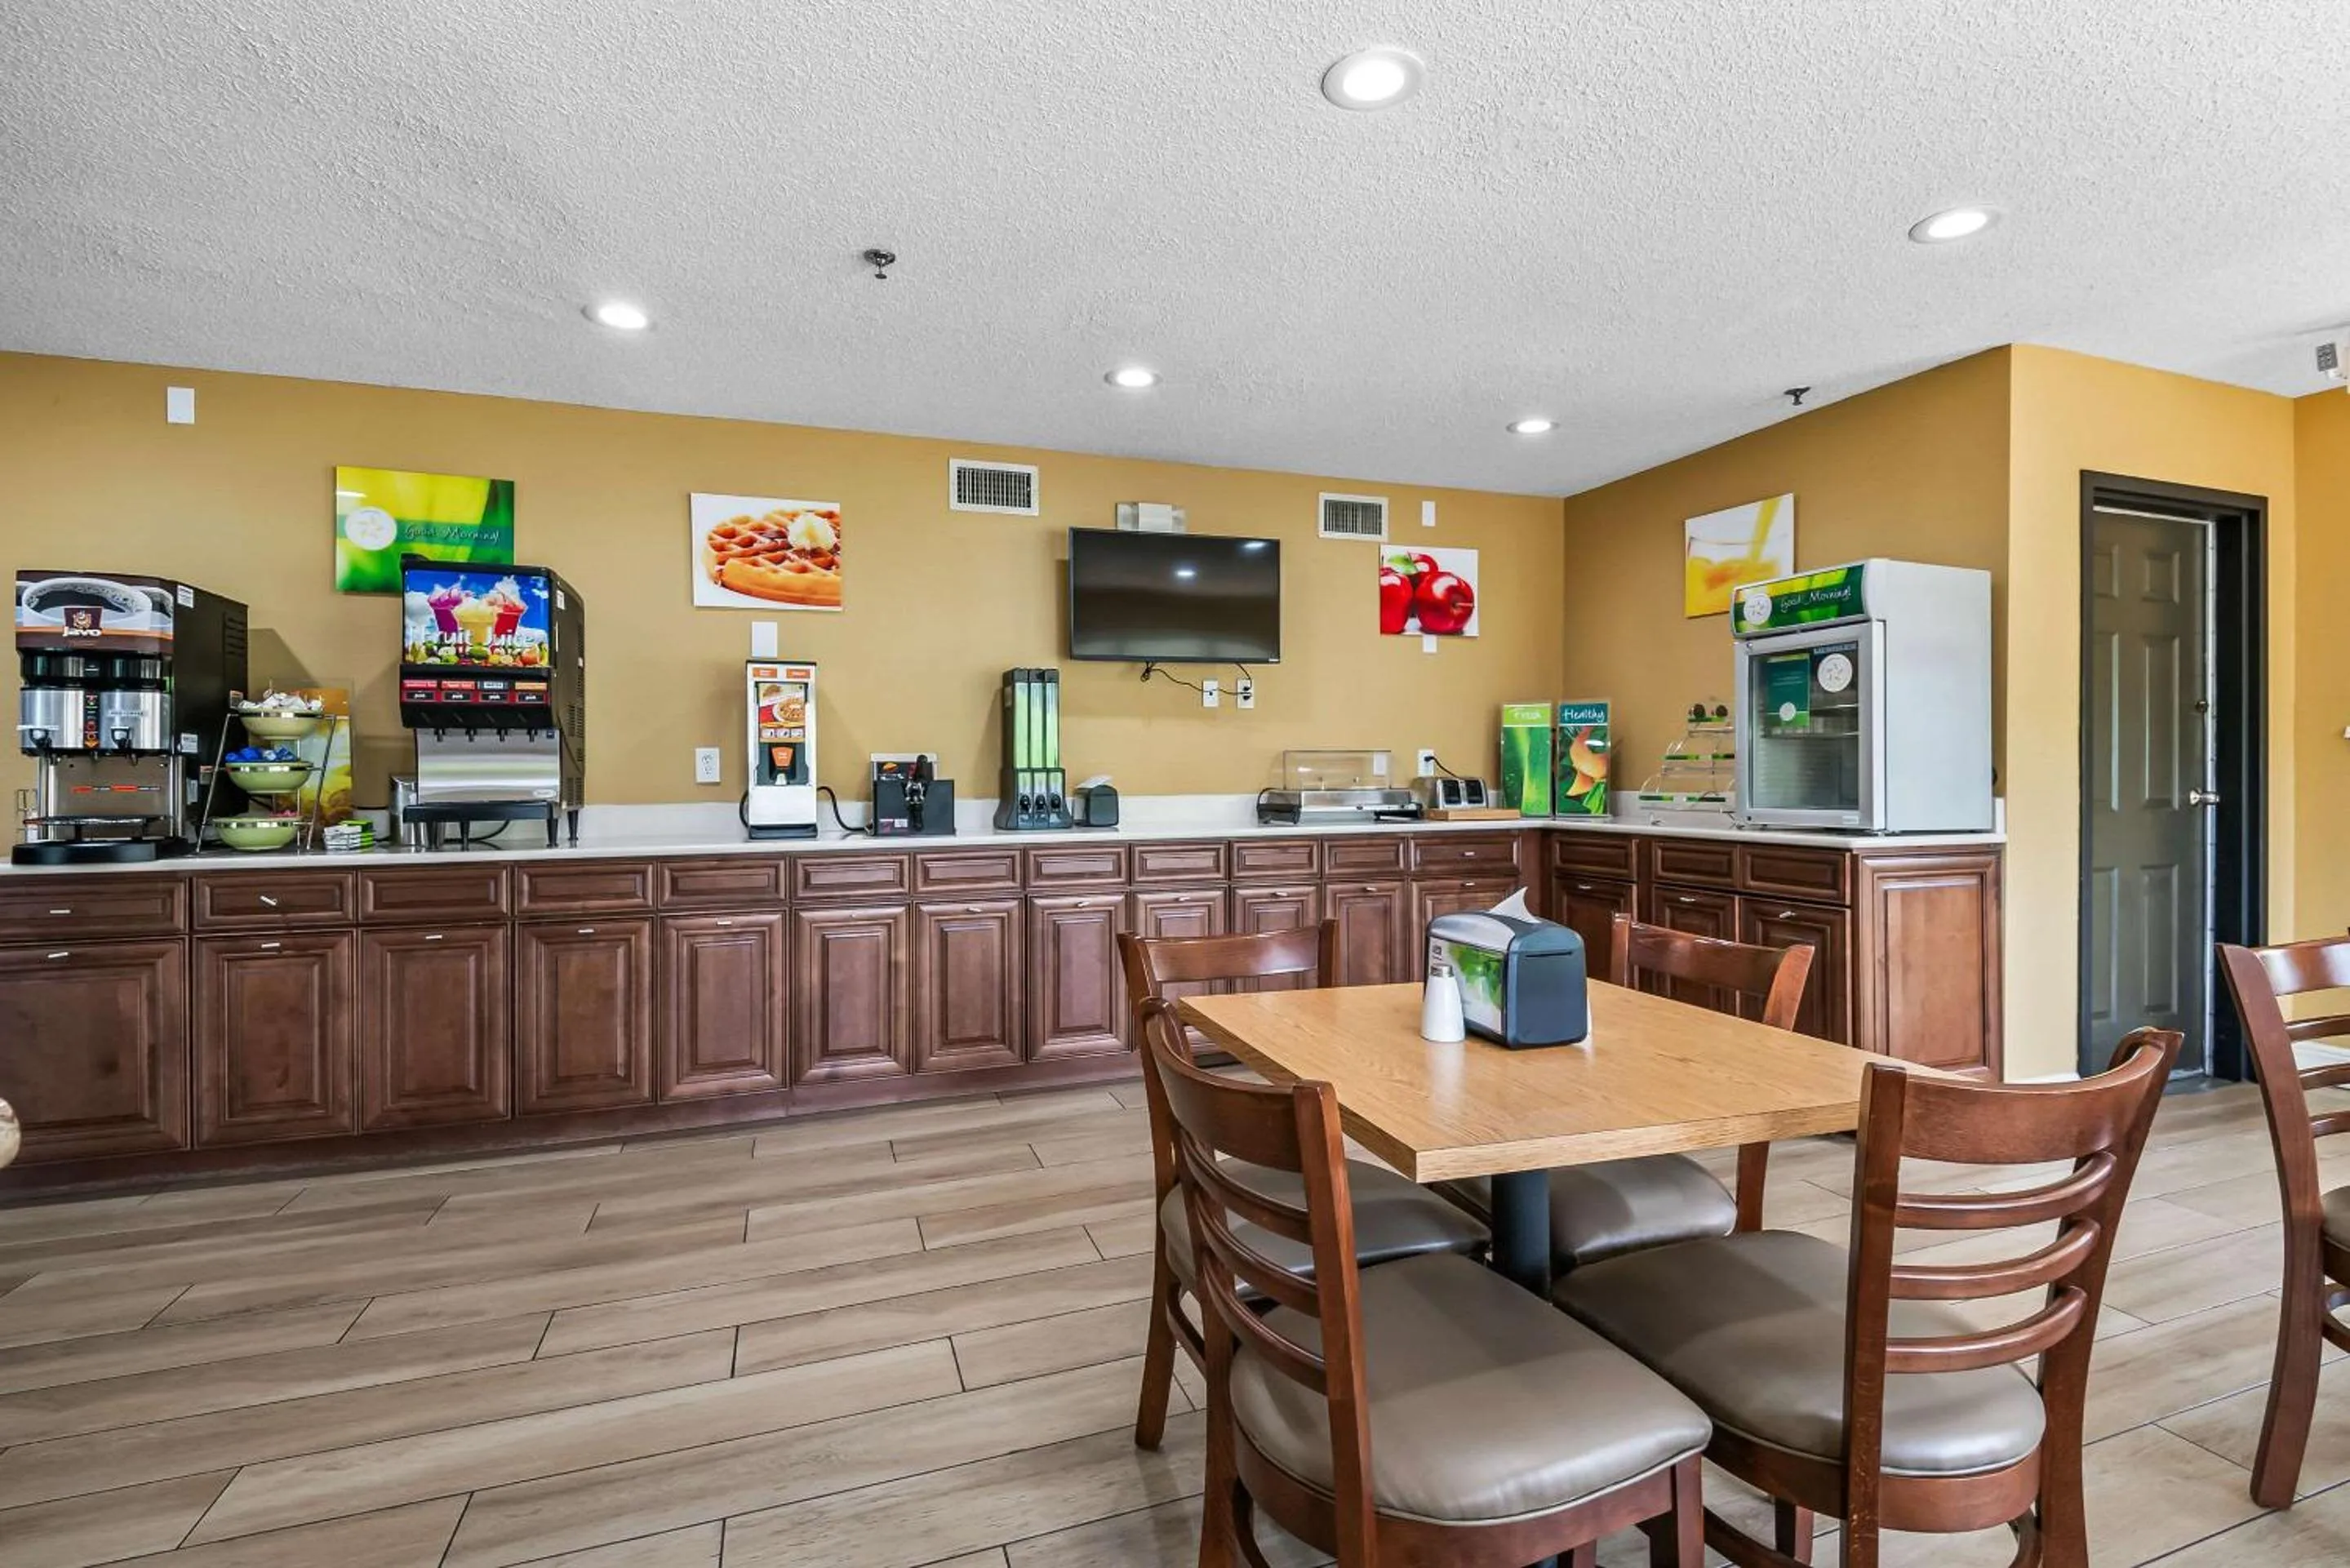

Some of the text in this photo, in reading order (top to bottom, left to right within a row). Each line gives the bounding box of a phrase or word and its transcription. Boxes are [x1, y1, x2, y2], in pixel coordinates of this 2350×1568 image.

[1780, 585, 1851, 613] Good Morning!
[1562, 708, 1605, 722] Healthy
